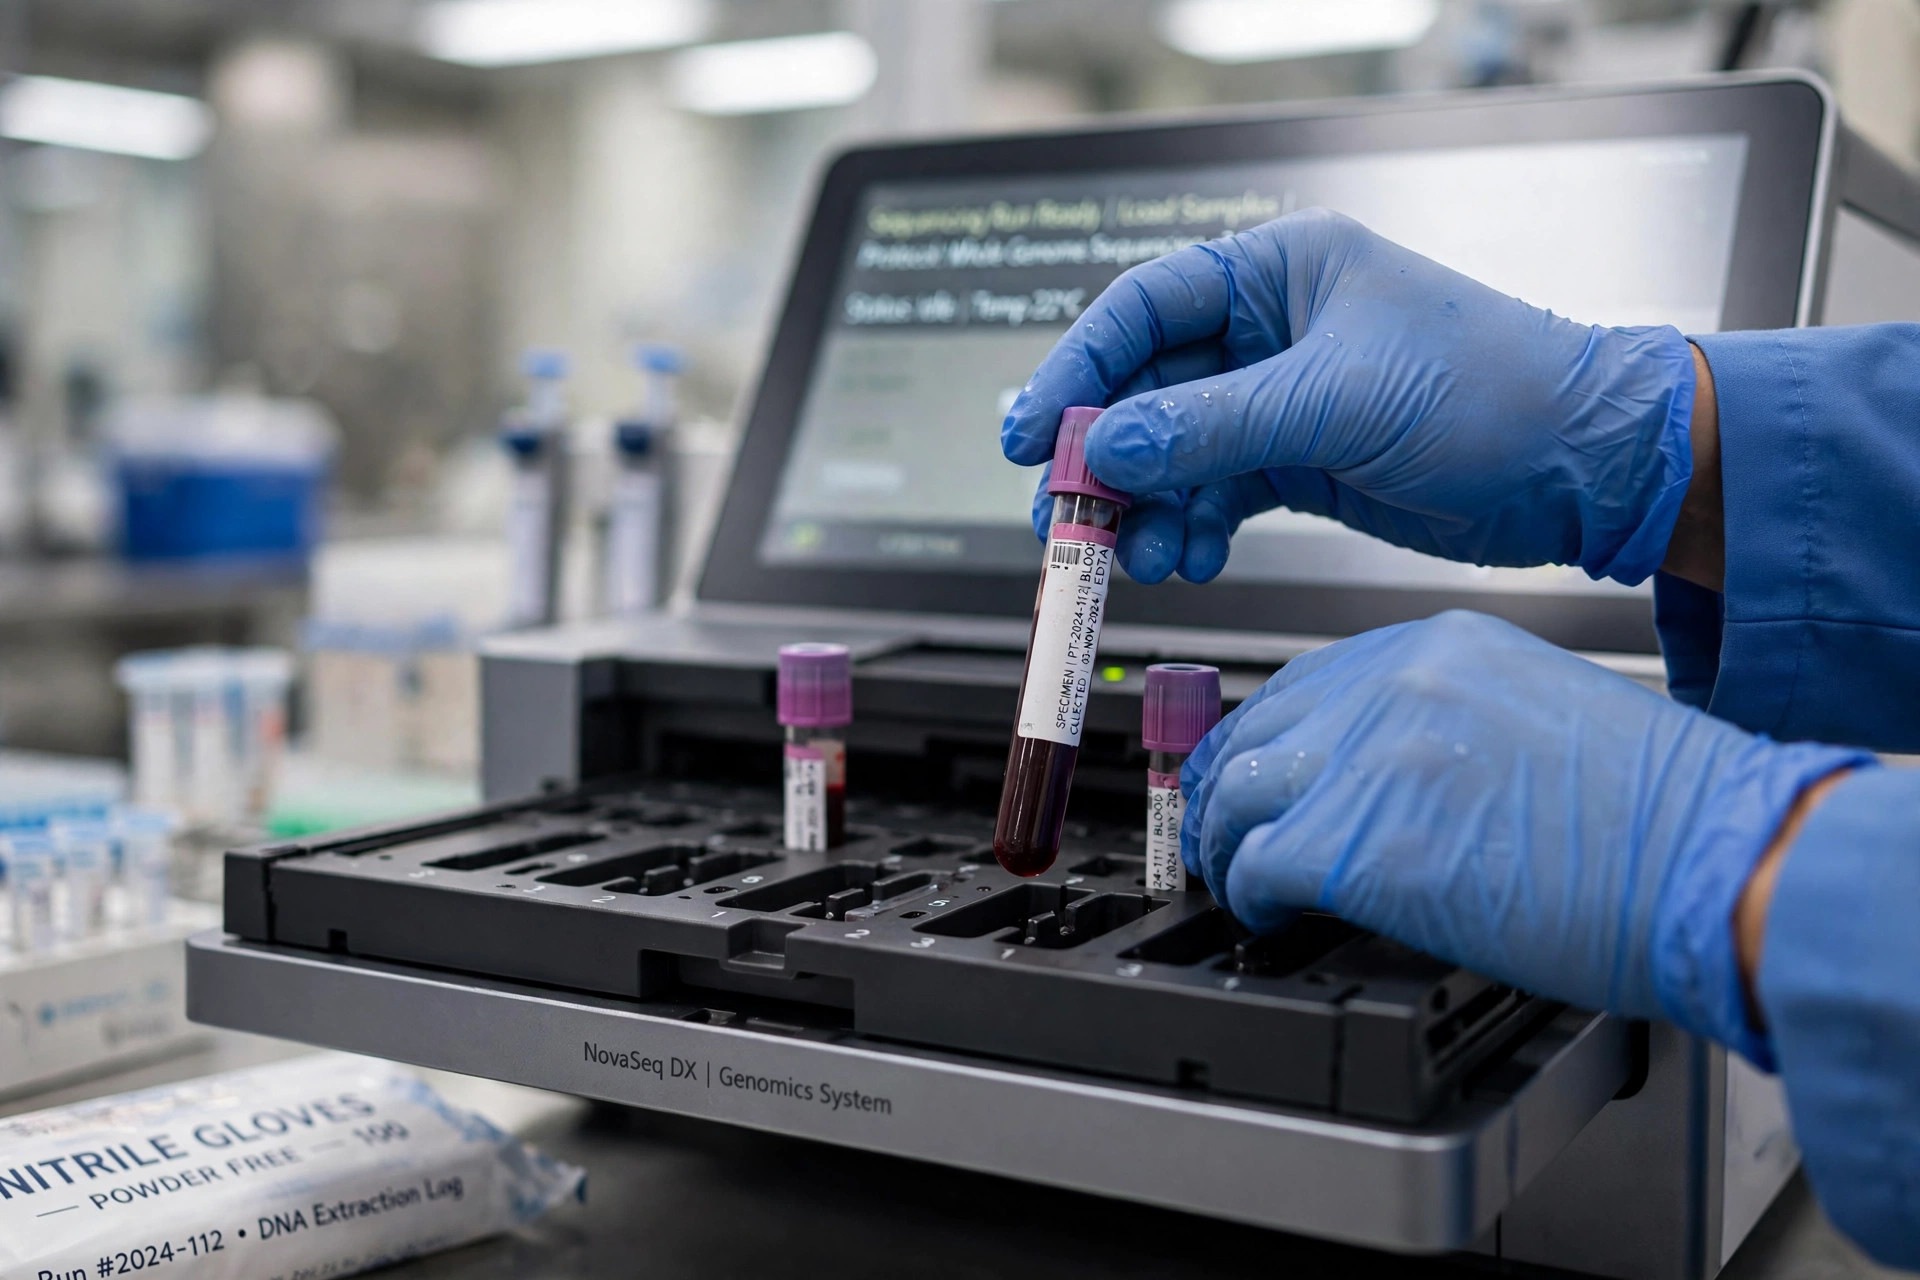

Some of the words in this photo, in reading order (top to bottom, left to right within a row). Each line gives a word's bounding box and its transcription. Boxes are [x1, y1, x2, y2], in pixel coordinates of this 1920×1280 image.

[1094, 549, 1109, 585] EDTA
[1056, 669, 1074, 729] SPECIMEN
[1153, 794, 1163, 836] BLOOD
[584, 1041, 664, 1080] NovaSeq
[670, 1057, 697, 1081] DX
[719, 1066, 813, 1101] Genomics
[819, 1083, 892, 1115] System
[0, 1133, 189, 1200] NITRILE
[193, 1094, 376, 1149] GLOVES
[88, 1165, 223, 1210] POWDER
[226, 1145, 303, 1176] FREE
[97, 1229, 225, 1279] #2024-112
[258, 1208, 309, 1241] DNA
[313, 1184, 422, 1226] Extraction
[423, 1175, 465, 1202] Log
